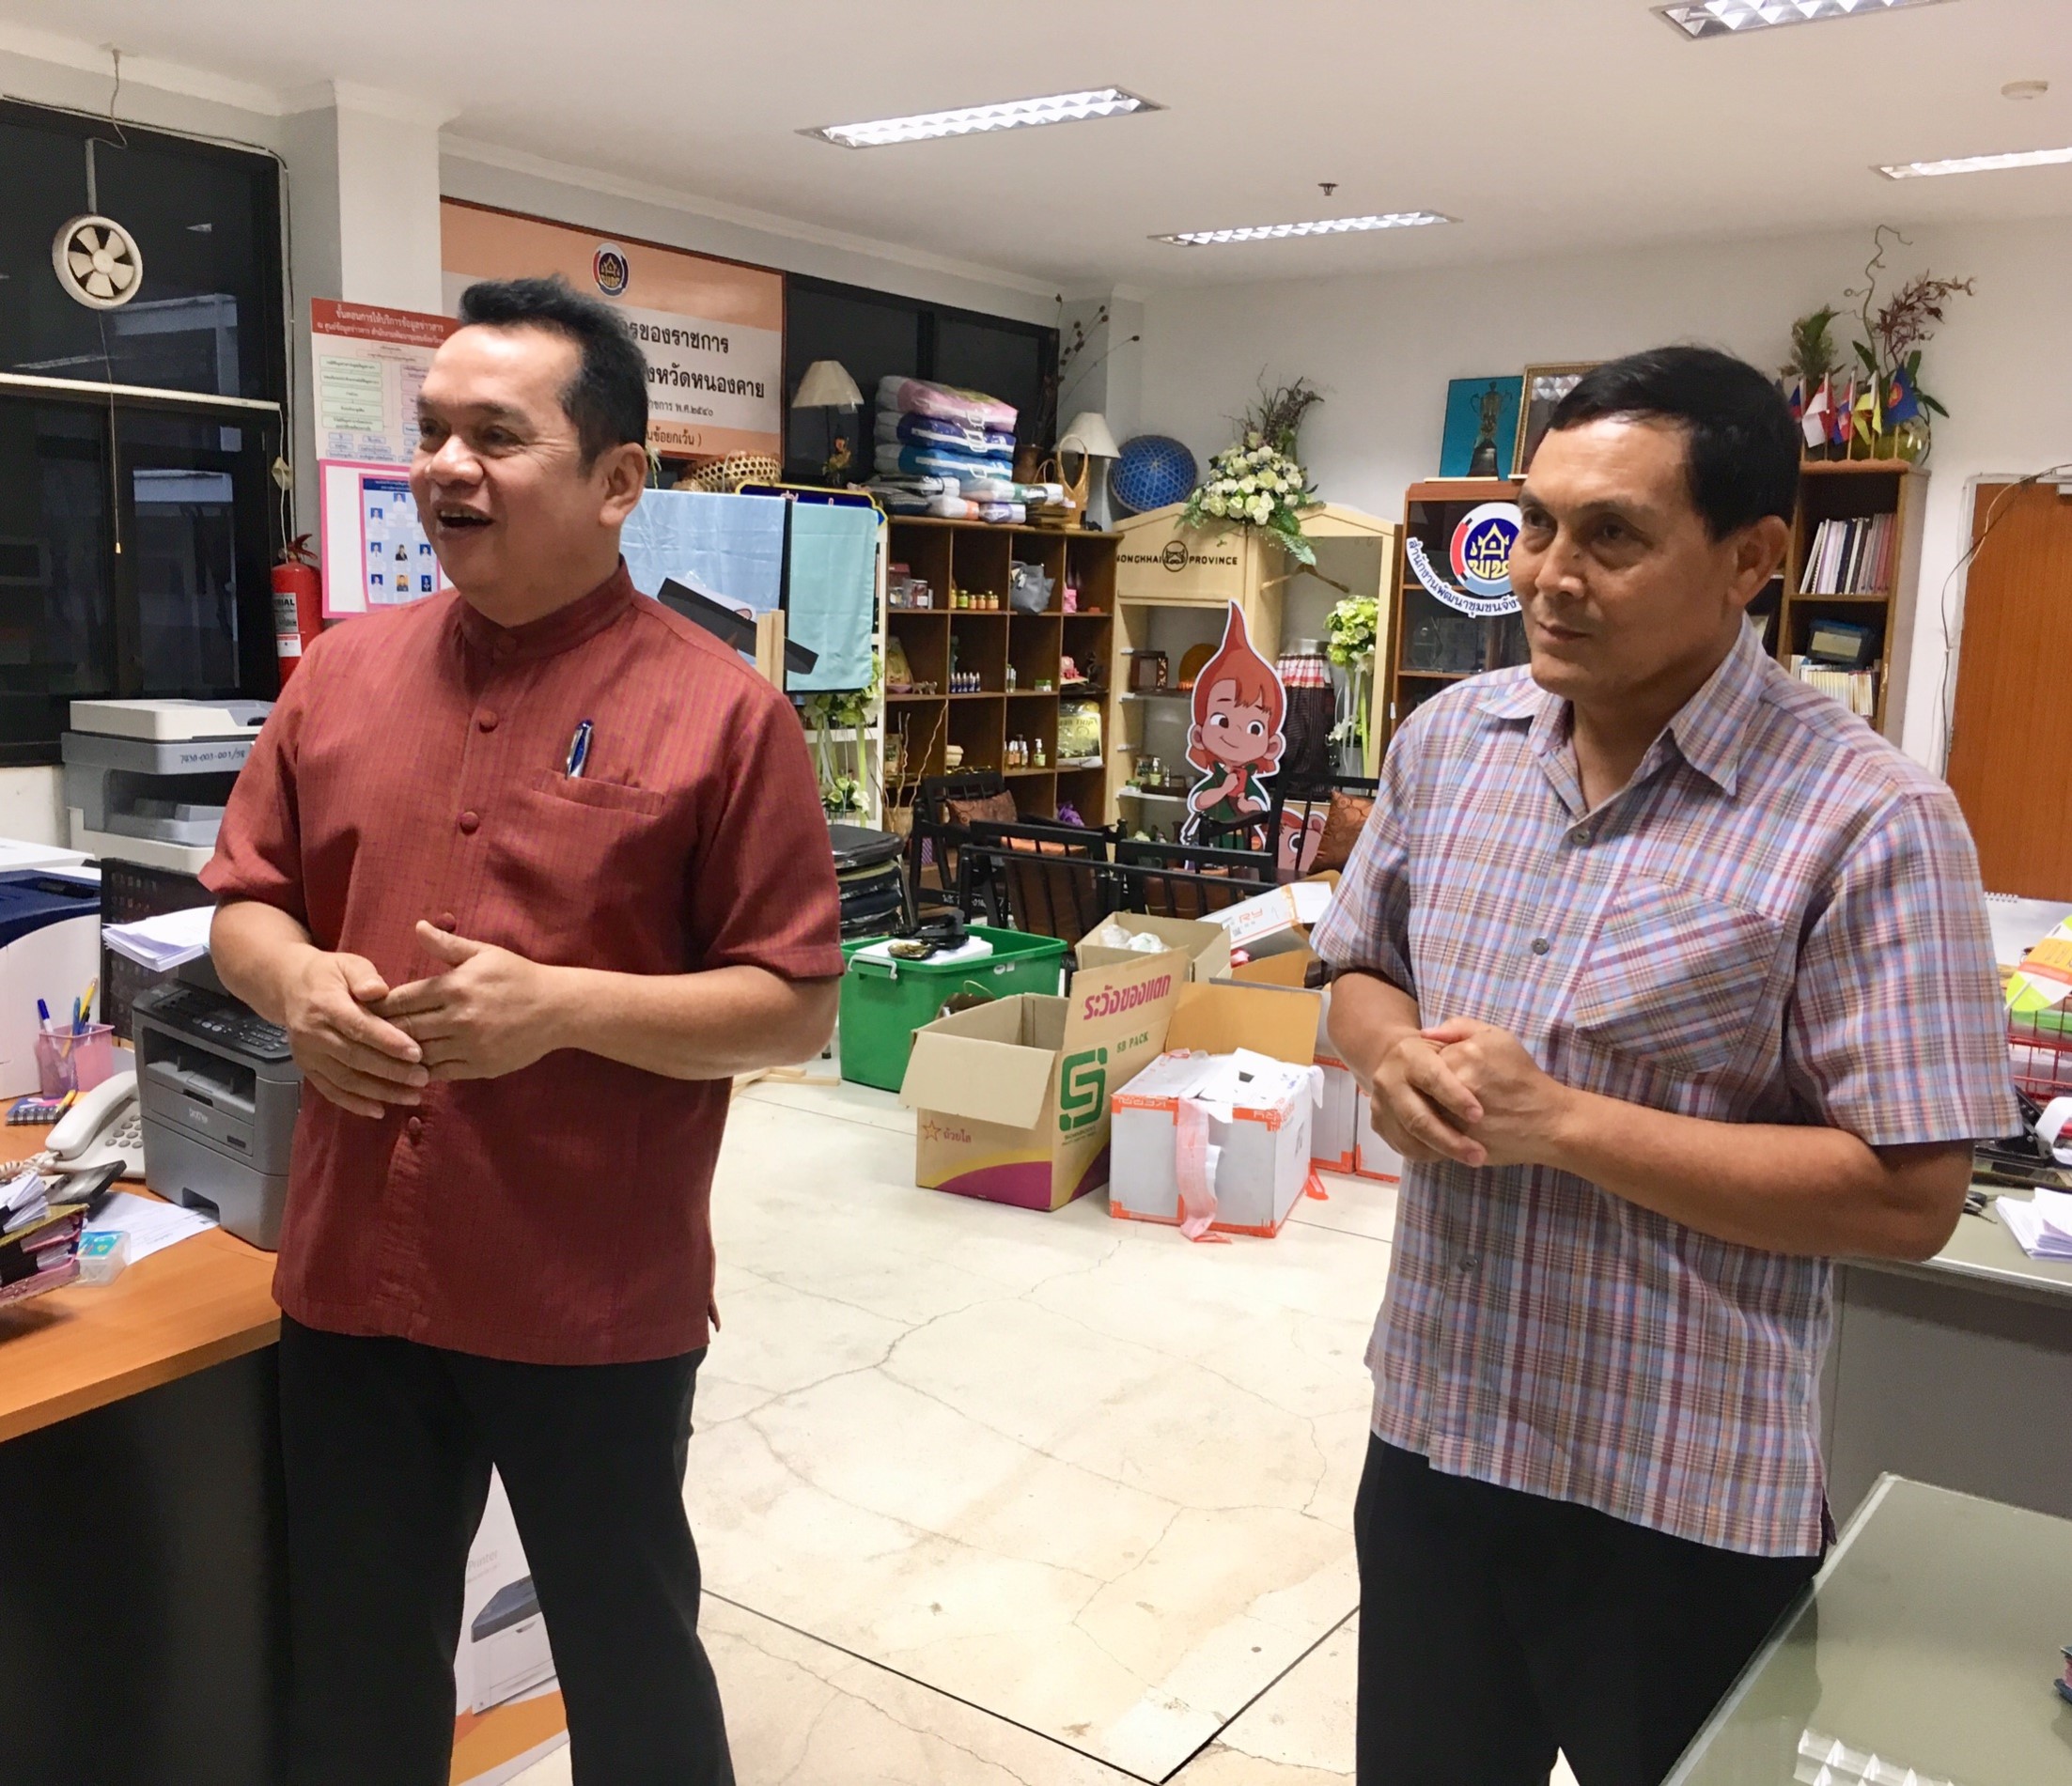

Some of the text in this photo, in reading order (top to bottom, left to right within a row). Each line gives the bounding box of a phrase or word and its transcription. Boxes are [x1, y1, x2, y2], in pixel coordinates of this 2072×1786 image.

[1189, 555, 1239, 566] PROVINCE
[1409, 539, 1519, 617] สำนักงานพัฒนาชุมชนจัง
[1083, 974, 1172, 1020] ระวังของแตก
[1129, 1032, 1149, 1048] PACK
